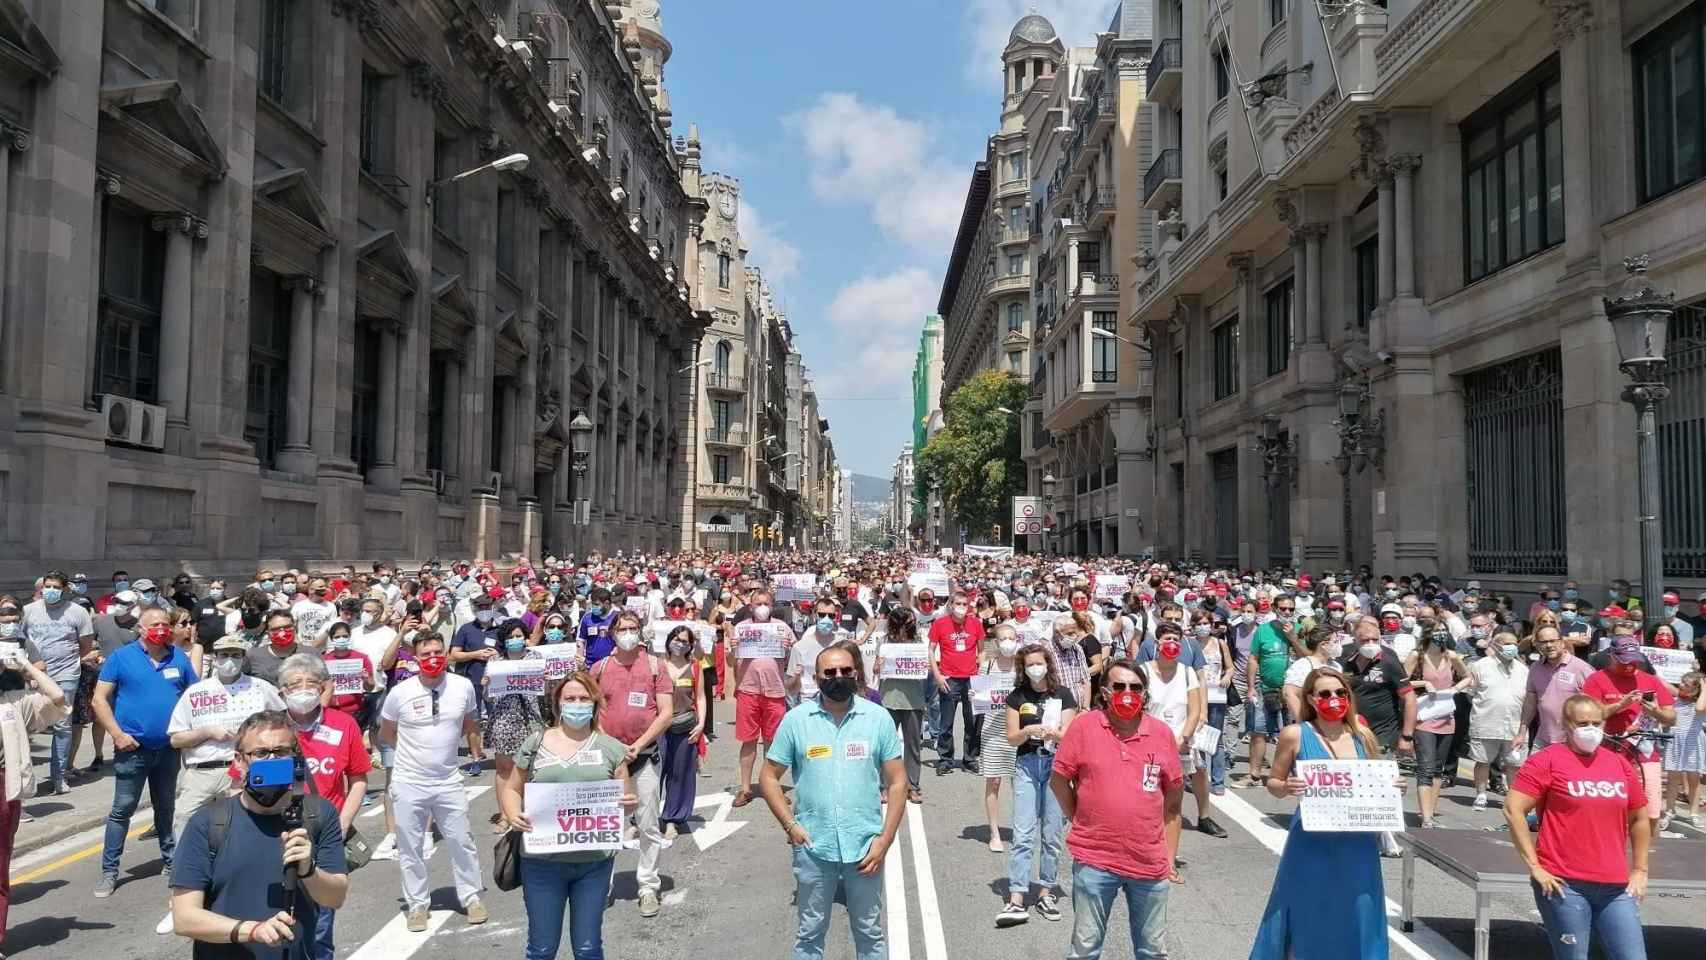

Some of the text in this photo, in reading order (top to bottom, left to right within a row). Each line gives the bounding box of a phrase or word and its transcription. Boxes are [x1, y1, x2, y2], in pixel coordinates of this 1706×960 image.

[895, 661, 928, 670] VIDES
[507, 677, 545, 685] VIDES
[190, 694, 228, 708] VIDES
[191, 704, 229, 717] DIGNES
[1303, 771, 1353, 787] VIDES
[1304, 786, 1354, 799] DIGNES
[557, 815, 621, 832] VIDES
[556, 831, 621, 845] DIGNES
